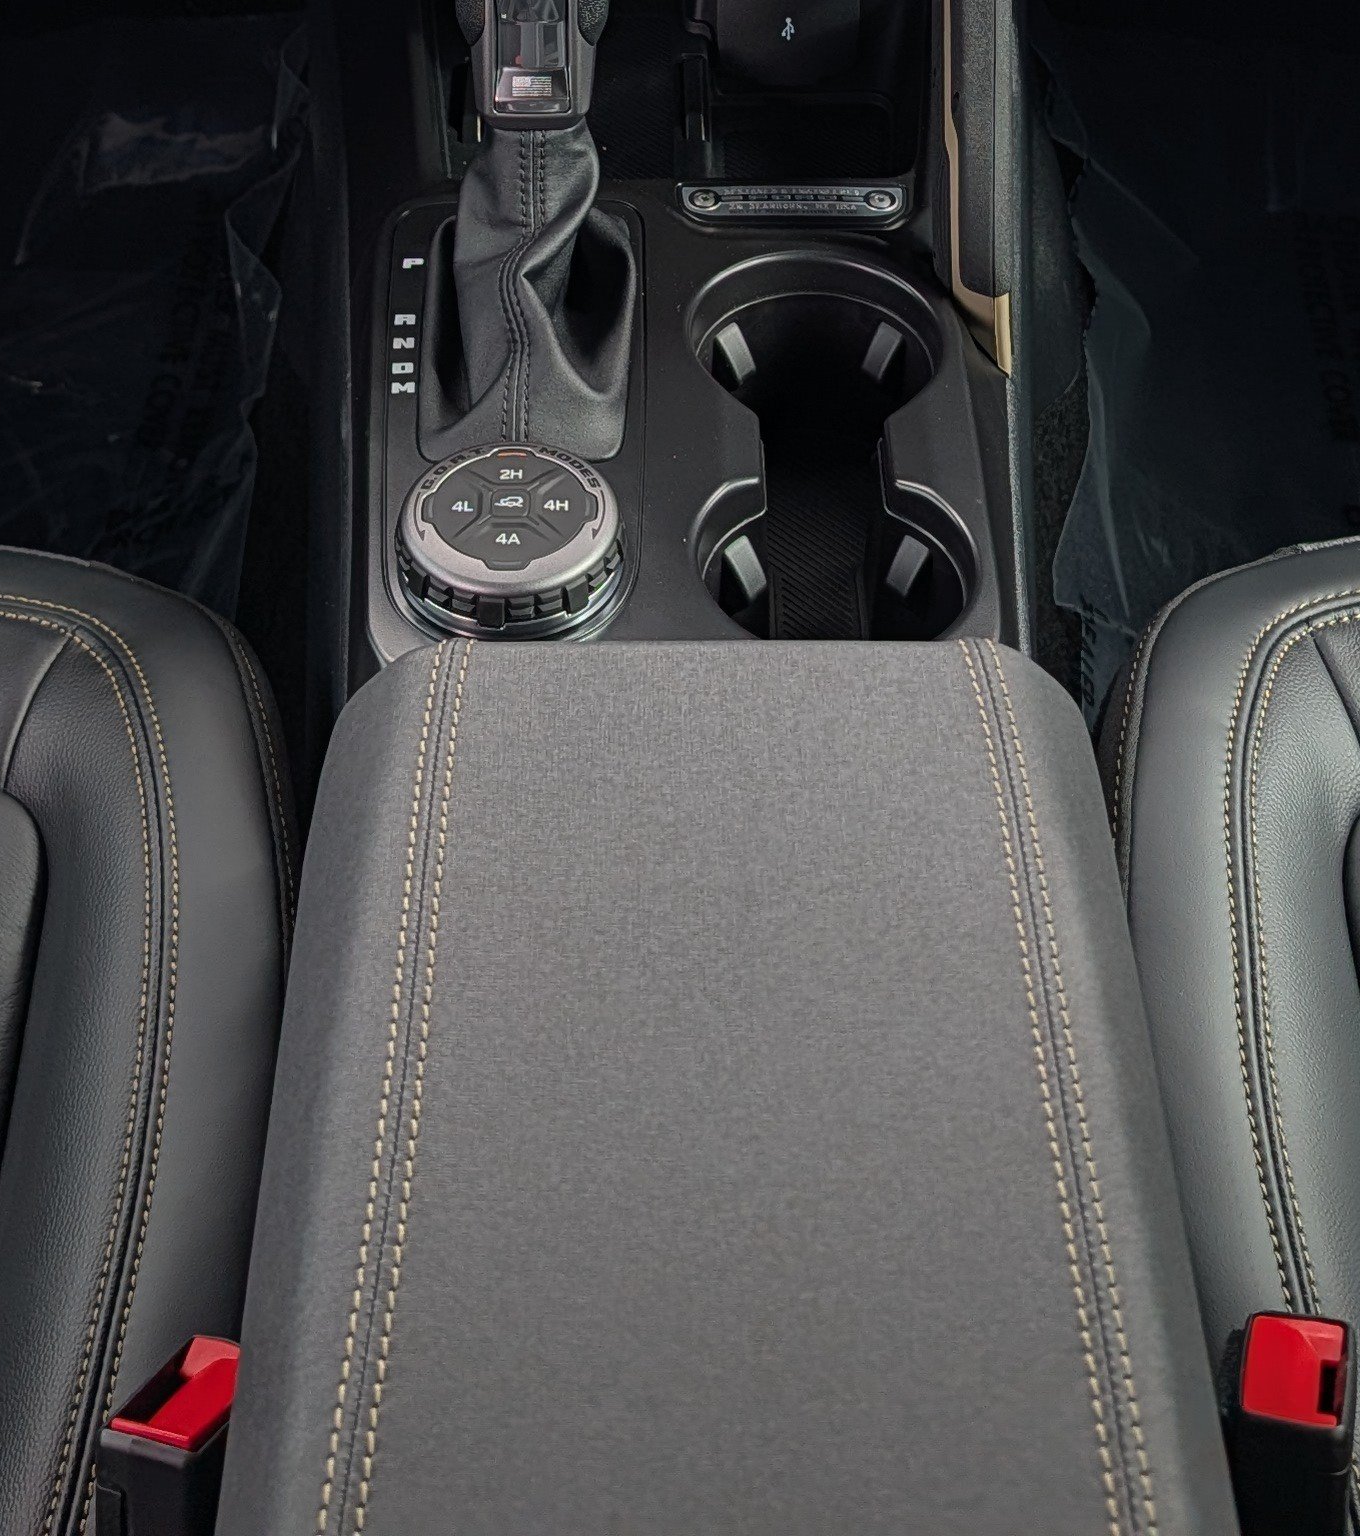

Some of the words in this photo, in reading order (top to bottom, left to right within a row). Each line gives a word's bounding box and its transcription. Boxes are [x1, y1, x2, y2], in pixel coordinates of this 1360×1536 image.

[401, 257, 425, 269] P
[393, 313, 417, 326] R
[392, 336, 416, 350] N
[391, 362, 414, 375] D
[390, 381, 416, 394] M
[499, 469, 523, 480] 2H
[539, 447, 601, 489] MODES
[451, 500, 474, 513] 4L
[543, 499, 569, 512] 4H
[495, 533, 521, 545] 4A
